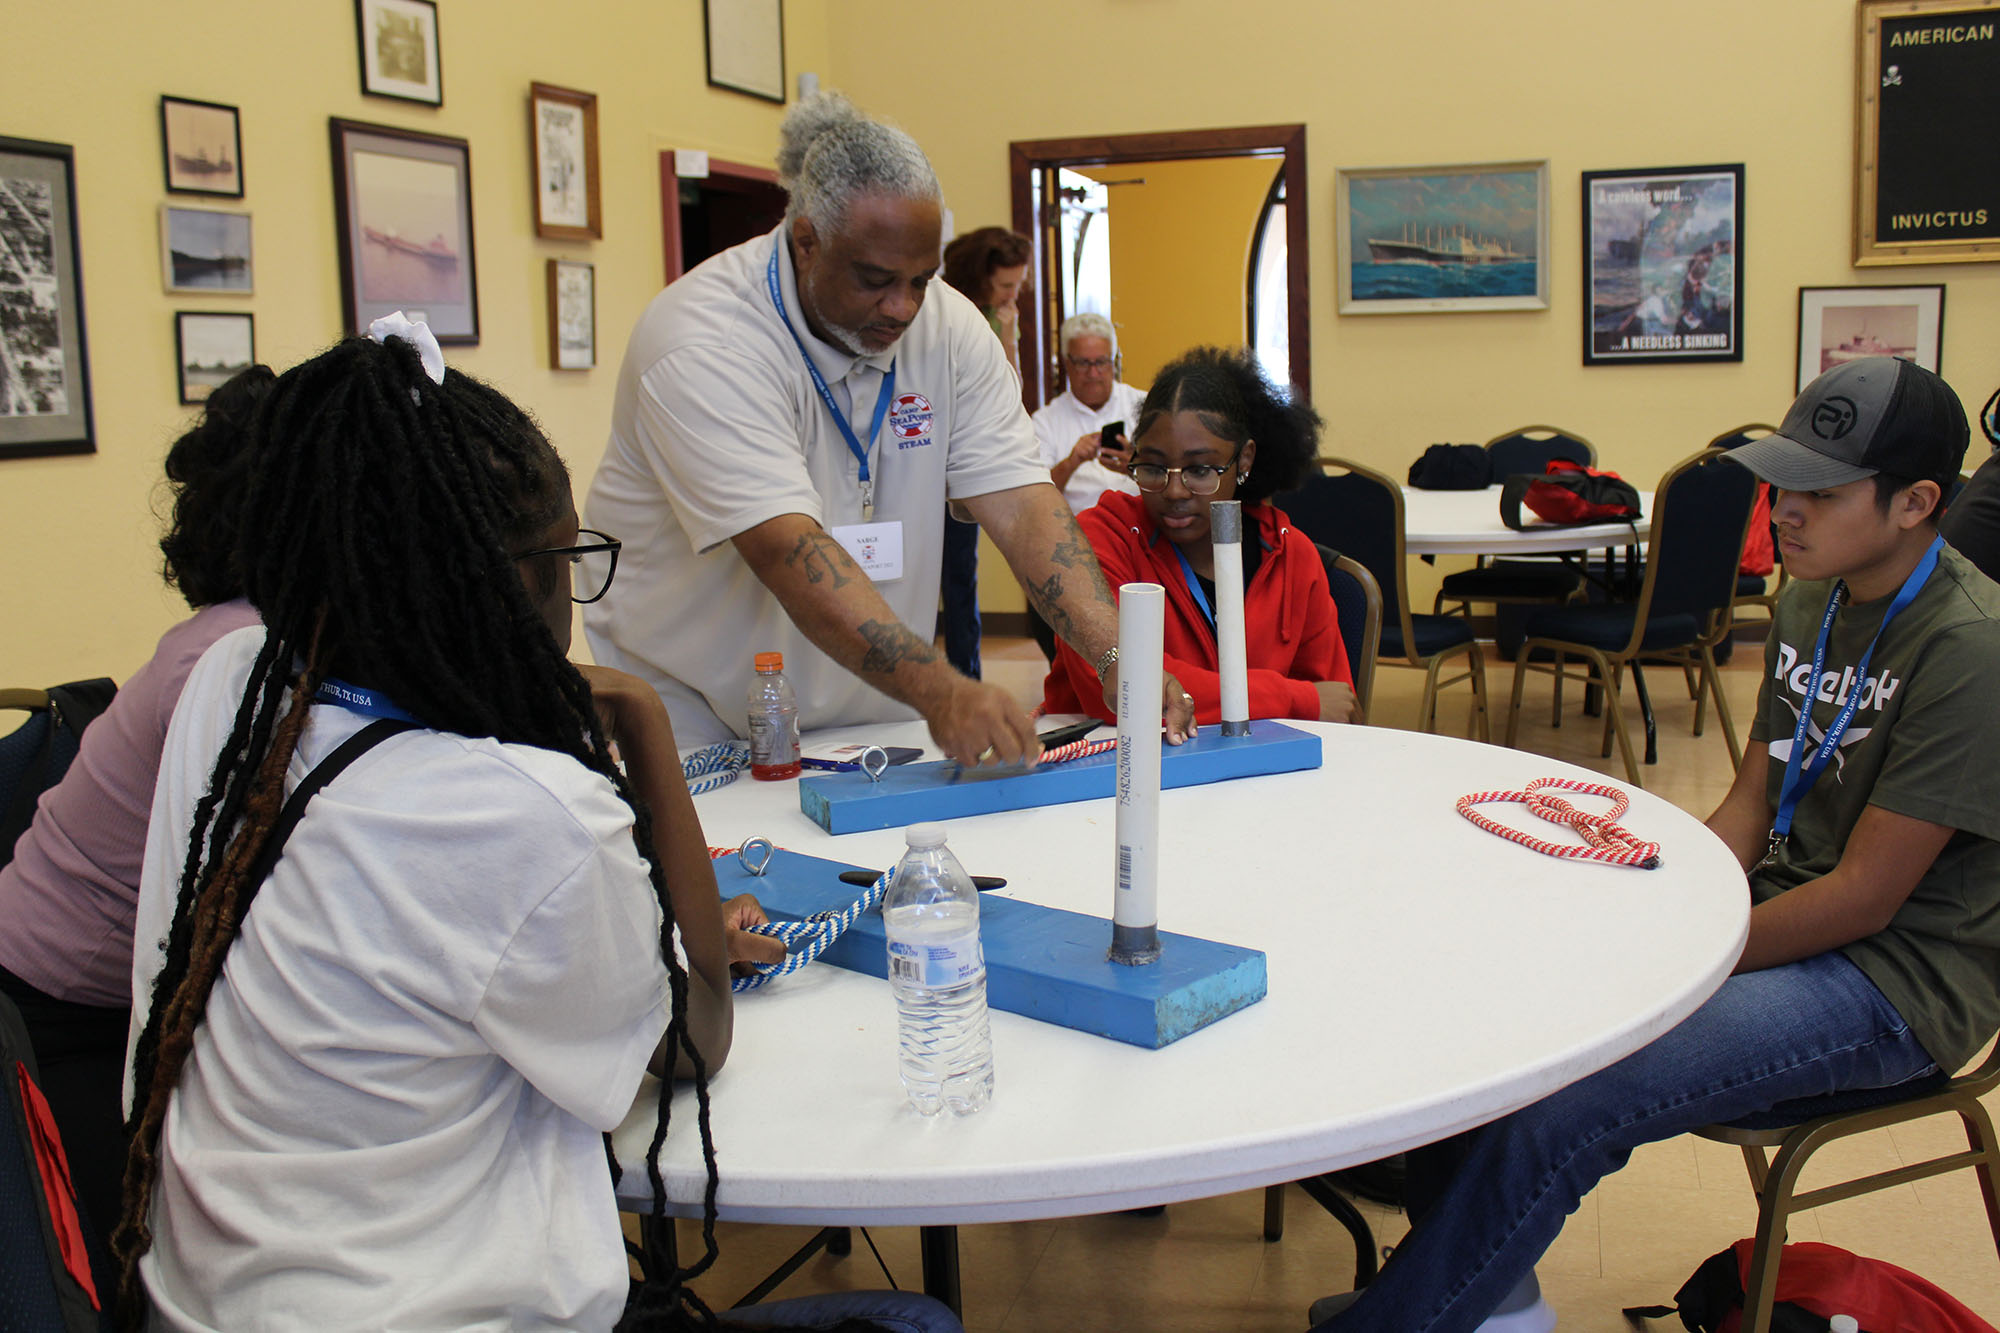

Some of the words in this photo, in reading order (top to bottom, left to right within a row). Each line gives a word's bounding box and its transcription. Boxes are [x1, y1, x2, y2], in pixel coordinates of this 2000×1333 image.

[1890, 24, 1994, 47] AMERICAN
[1892, 209, 1988, 229] INVICTUS
[1630, 335, 1681, 350] NEEDLESS
[1683, 333, 1728, 348] SINKING
[898, 438, 931, 450] STEAM
[320, 682, 342, 698] THUR,
[352, 693, 373, 706] USA
[1848, 694, 1858, 711] PORT
[1803, 698, 1811, 715] PORT
[1801, 713, 1807, 724] OF
[1797, 724, 1805, 742] PORT
[1827, 736, 1837, 747] TX
[1820, 746, 1832, 759] USA
